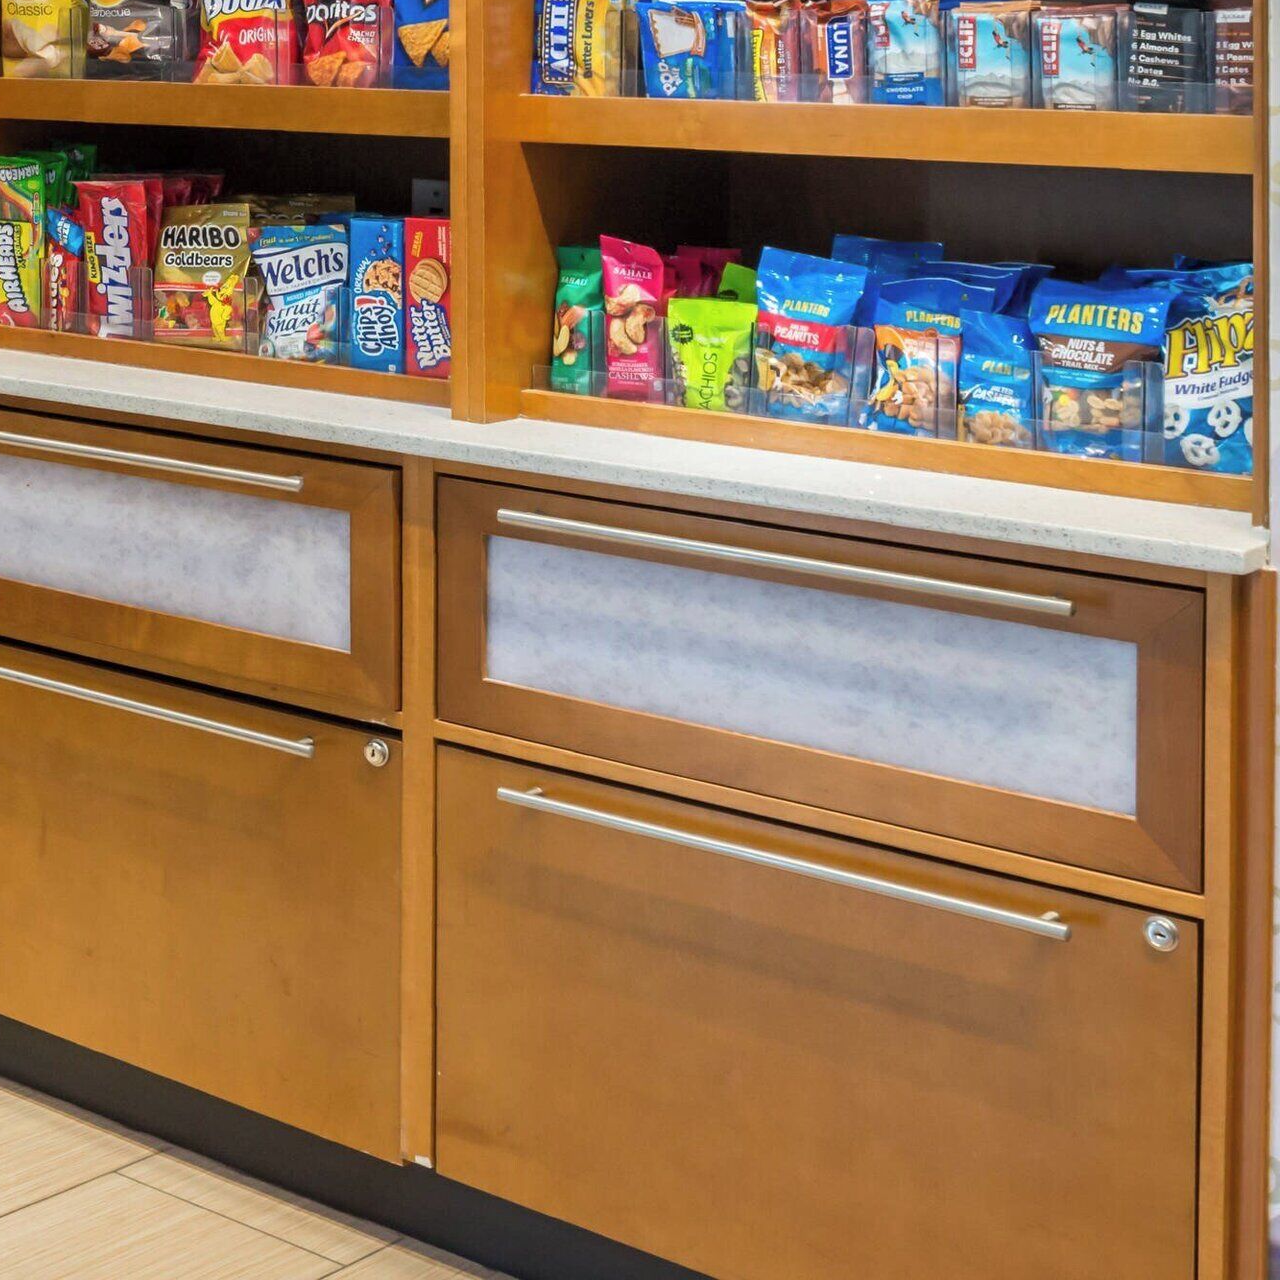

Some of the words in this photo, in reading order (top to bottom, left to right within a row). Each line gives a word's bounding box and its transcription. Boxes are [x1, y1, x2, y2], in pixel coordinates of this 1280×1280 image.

[7, 1, 53, 17] Classic
[306, 1, 377, 23] Doritos
[347, 34, 377, 45] CHEESE
[349, 28, 376, 39] NACHO
[958, 18, 975, 58] CLIF
[1140, 30, 1157, 41] Egg
[1158, 31, 1192, 42] Whites
[832, 20, 849, 75] LUNA
[1042, 23, 1059, 64] CLIF
[1140, 42, 1180, 53] Almonds
[1222, 41, 1241, 51] Egg
[1138, 54, 1180, 65] Cashews
[1137, 66, 1164, 76] Dates
[886, 85, 925, 94] CHOCOLATE
[161, 225, 241, 250] HARIBO
[164, 252, 233, 268] Goldbears
[258, 248, 345, 288] Welch's
[353, 257, 373, 293] ORIGINAL
[612, 267, 653, 280] SAHALE
[782, 299, 831, 318] PLANTERS
[905, 310, 962, 330] PLANTERS
[1045, 303, 1145, 335] PLANTERS
[358, 305, 380, 356] Chips
[410, 306, 437, 369] Nutter
[423, 298, 451, 361] Butter
[773, 325, 820, 346] PEANUTS
[1067, 337, 1097, 351] NUTS
[1096, 340, 1106, 353] &
[1051, 346, 1115, 367] CHOCOLATE
[1061, 360, 1082, 370] TRAIL
[1083, 363, 1099, 371] MIX
[608, 371, 656, 381] CASHEWS
[1174, 381, 1218, 397] White
